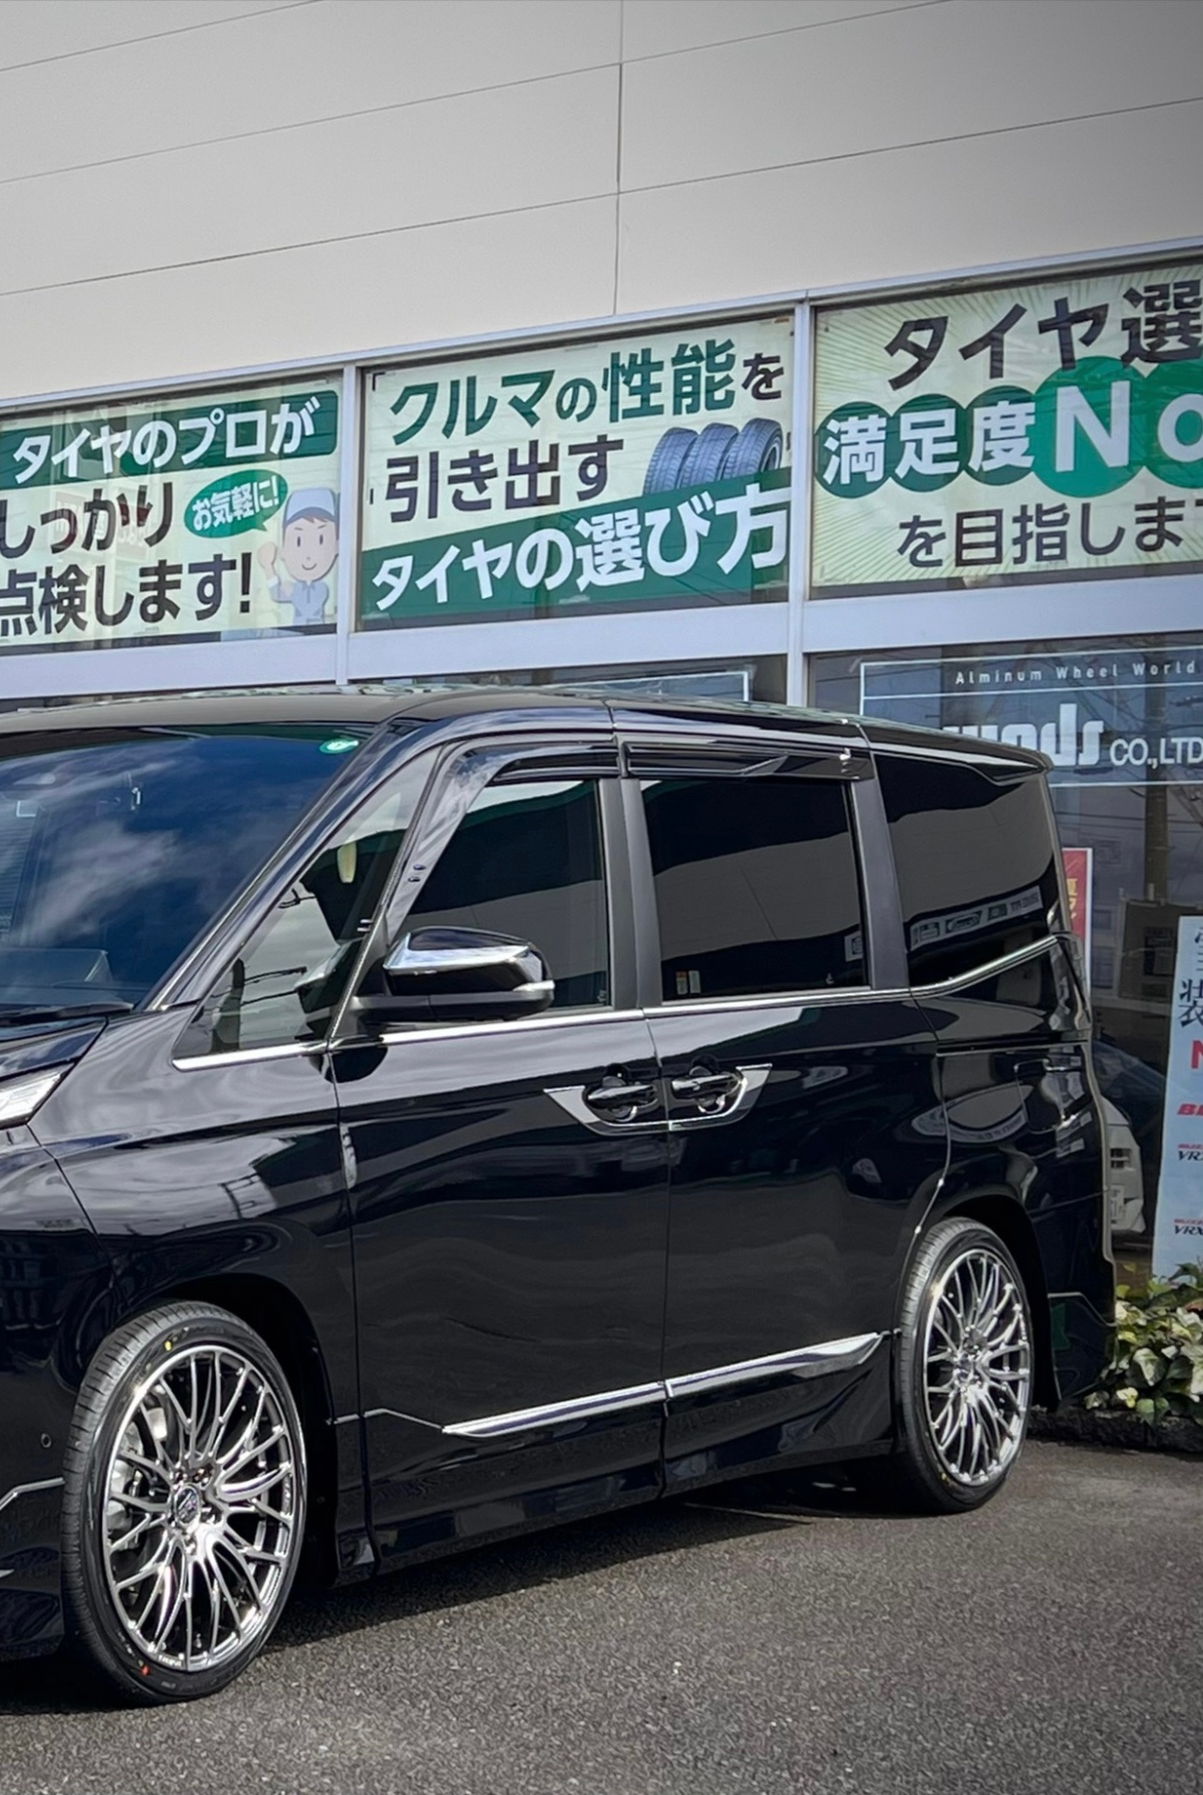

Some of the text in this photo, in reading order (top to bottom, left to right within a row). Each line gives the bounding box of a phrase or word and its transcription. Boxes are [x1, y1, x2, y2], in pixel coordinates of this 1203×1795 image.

[884, 279, 1203, 391] タイヤ選
[390, 339, 784, 446] クルマの性能を
[13, 396, 321, 484] タイヤのプロが
[385, 434, 624, 524] 引き出す
[192, 475, 280, 531] お気軽に!
[372, 482, 792, 611] タイヤの選び方
[897, 496, 1203, 568] を目指しま
[955, 660, 1195, 685] Alminum Wheel World
